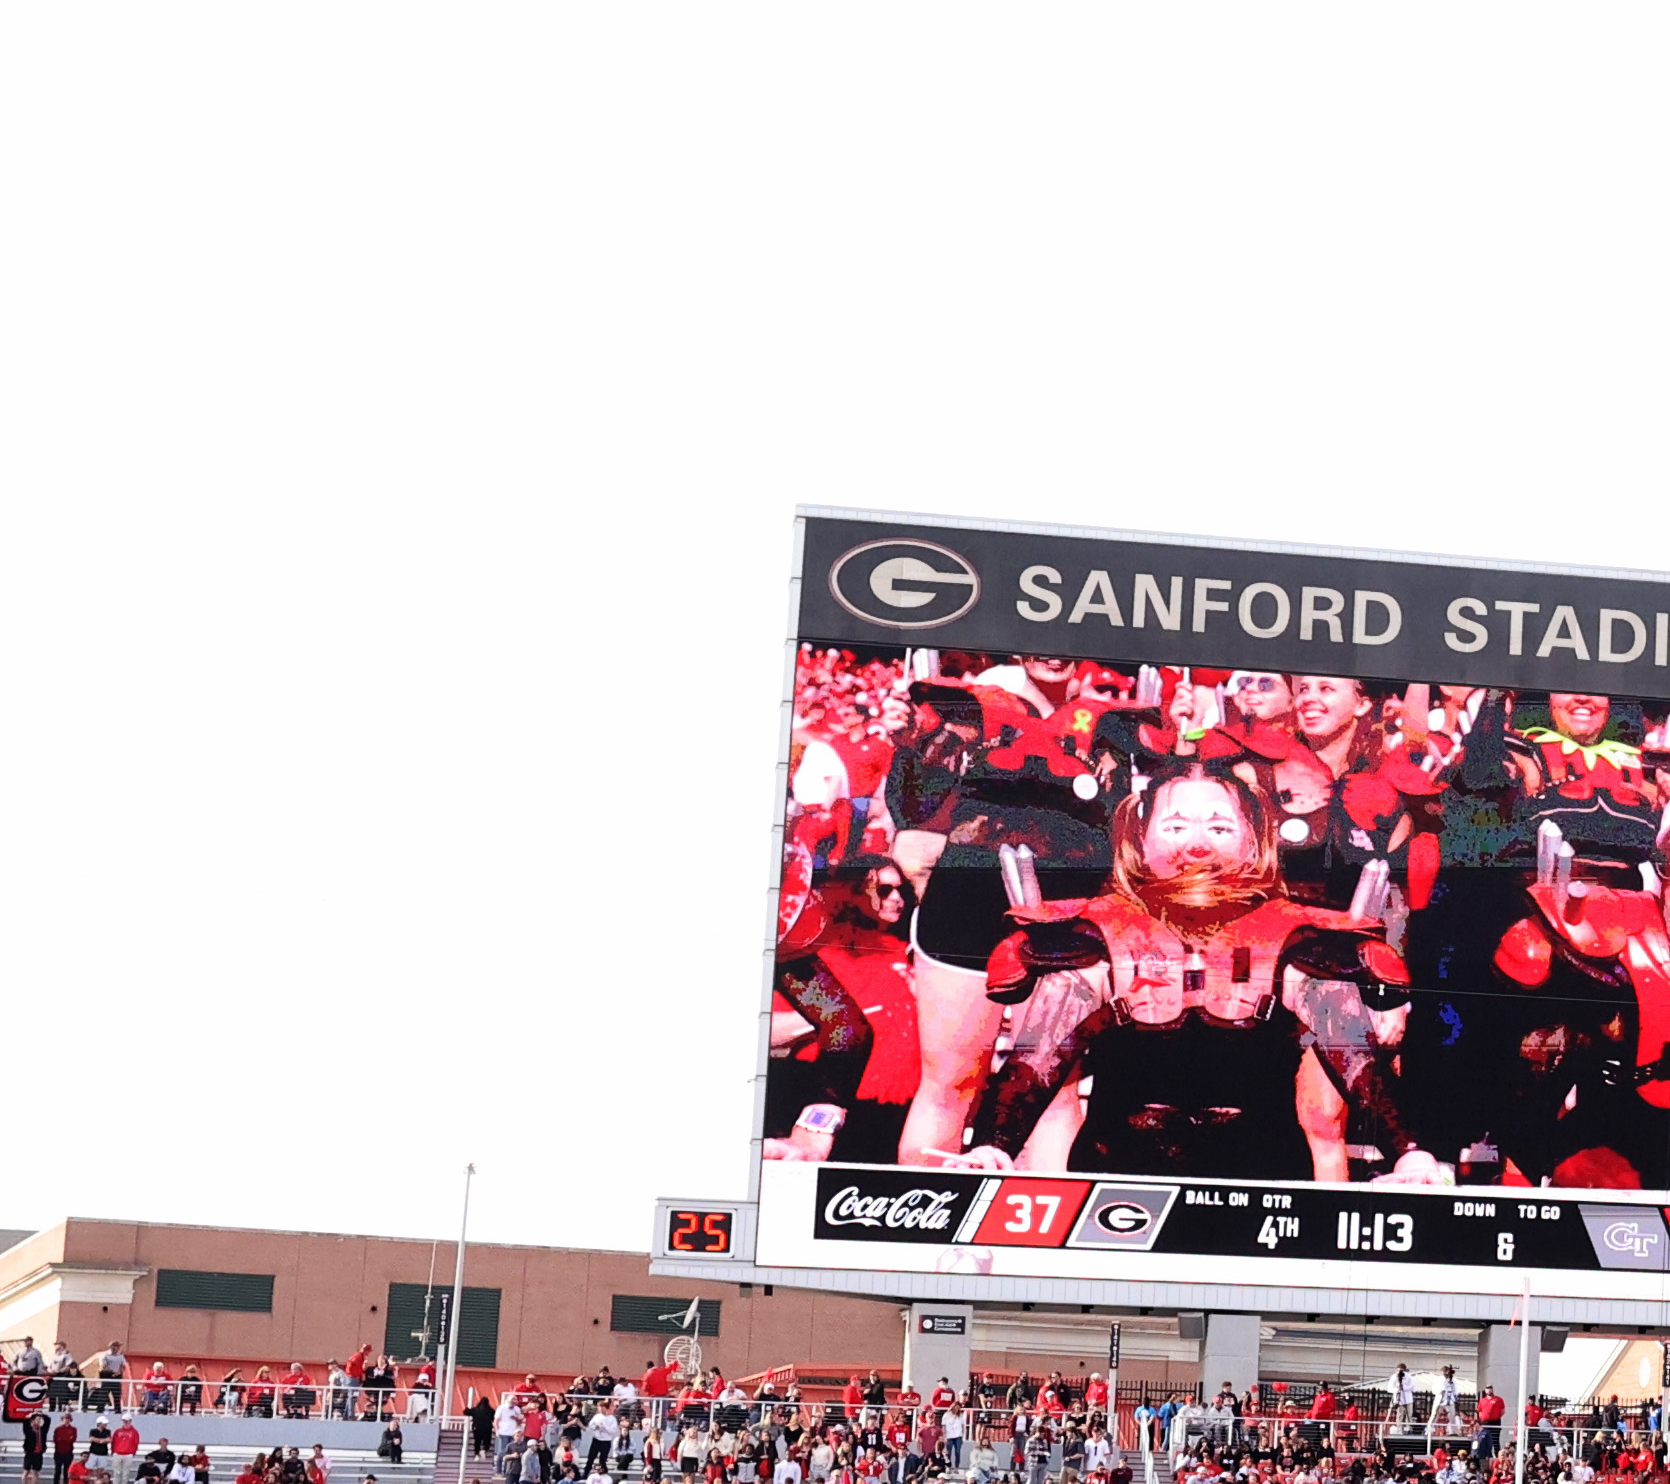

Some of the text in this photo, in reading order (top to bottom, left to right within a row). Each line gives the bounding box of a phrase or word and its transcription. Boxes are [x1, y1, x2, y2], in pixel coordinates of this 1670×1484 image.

[1016, 566, 1402, 644] SANFORD
[825, 1186, 957, 1231] Coca-Cola
[1005, 1195, 1061, 1233] 37
[1185, 1191, 1249, 1207] BALL ON
[1262, 1193, 1292, 1209] QTR
[1453, 1201, 1561, 1220] DOWN TO GO
[672, 1212, 729, 1252] 25
[1257, 1216, 1300, 1250] 4TH
[1336, 1213, 1414, 1252] 11:13
[1496, 1233, 1515, 1260] &
